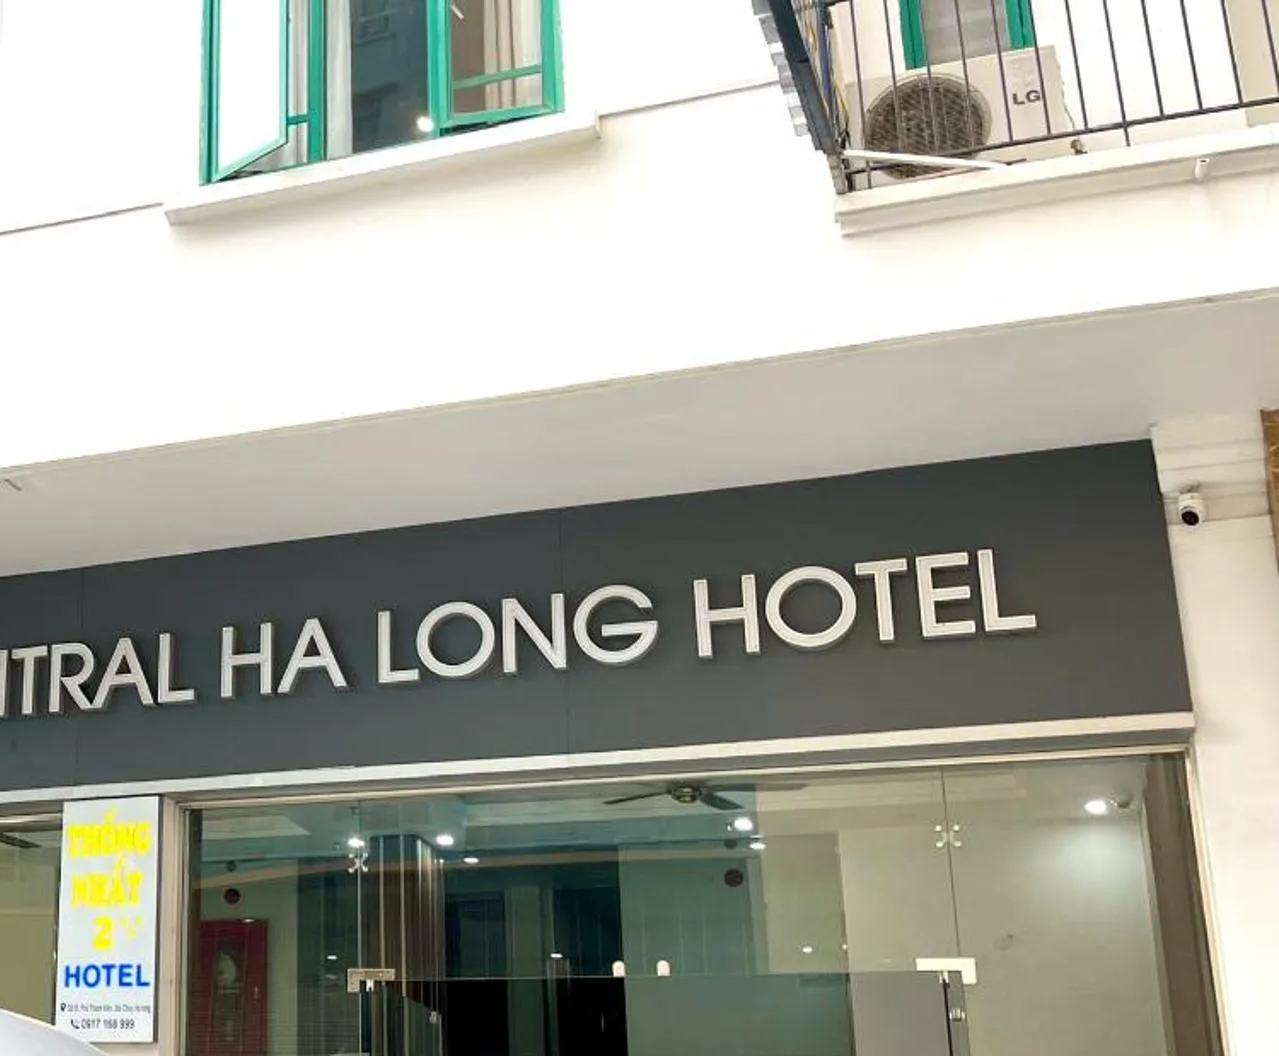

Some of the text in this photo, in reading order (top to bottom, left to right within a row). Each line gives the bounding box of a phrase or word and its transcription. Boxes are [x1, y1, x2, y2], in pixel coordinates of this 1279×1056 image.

[1012, 90, 1041, 105] LG
[220, 617, 347, 698] HA
[378, 584, 658, 683] LONG
[693, 549, 1036, 658] HOTEL
[92, 916, 115, 950] 2
[64, 963, 150, 988] HOTEL
